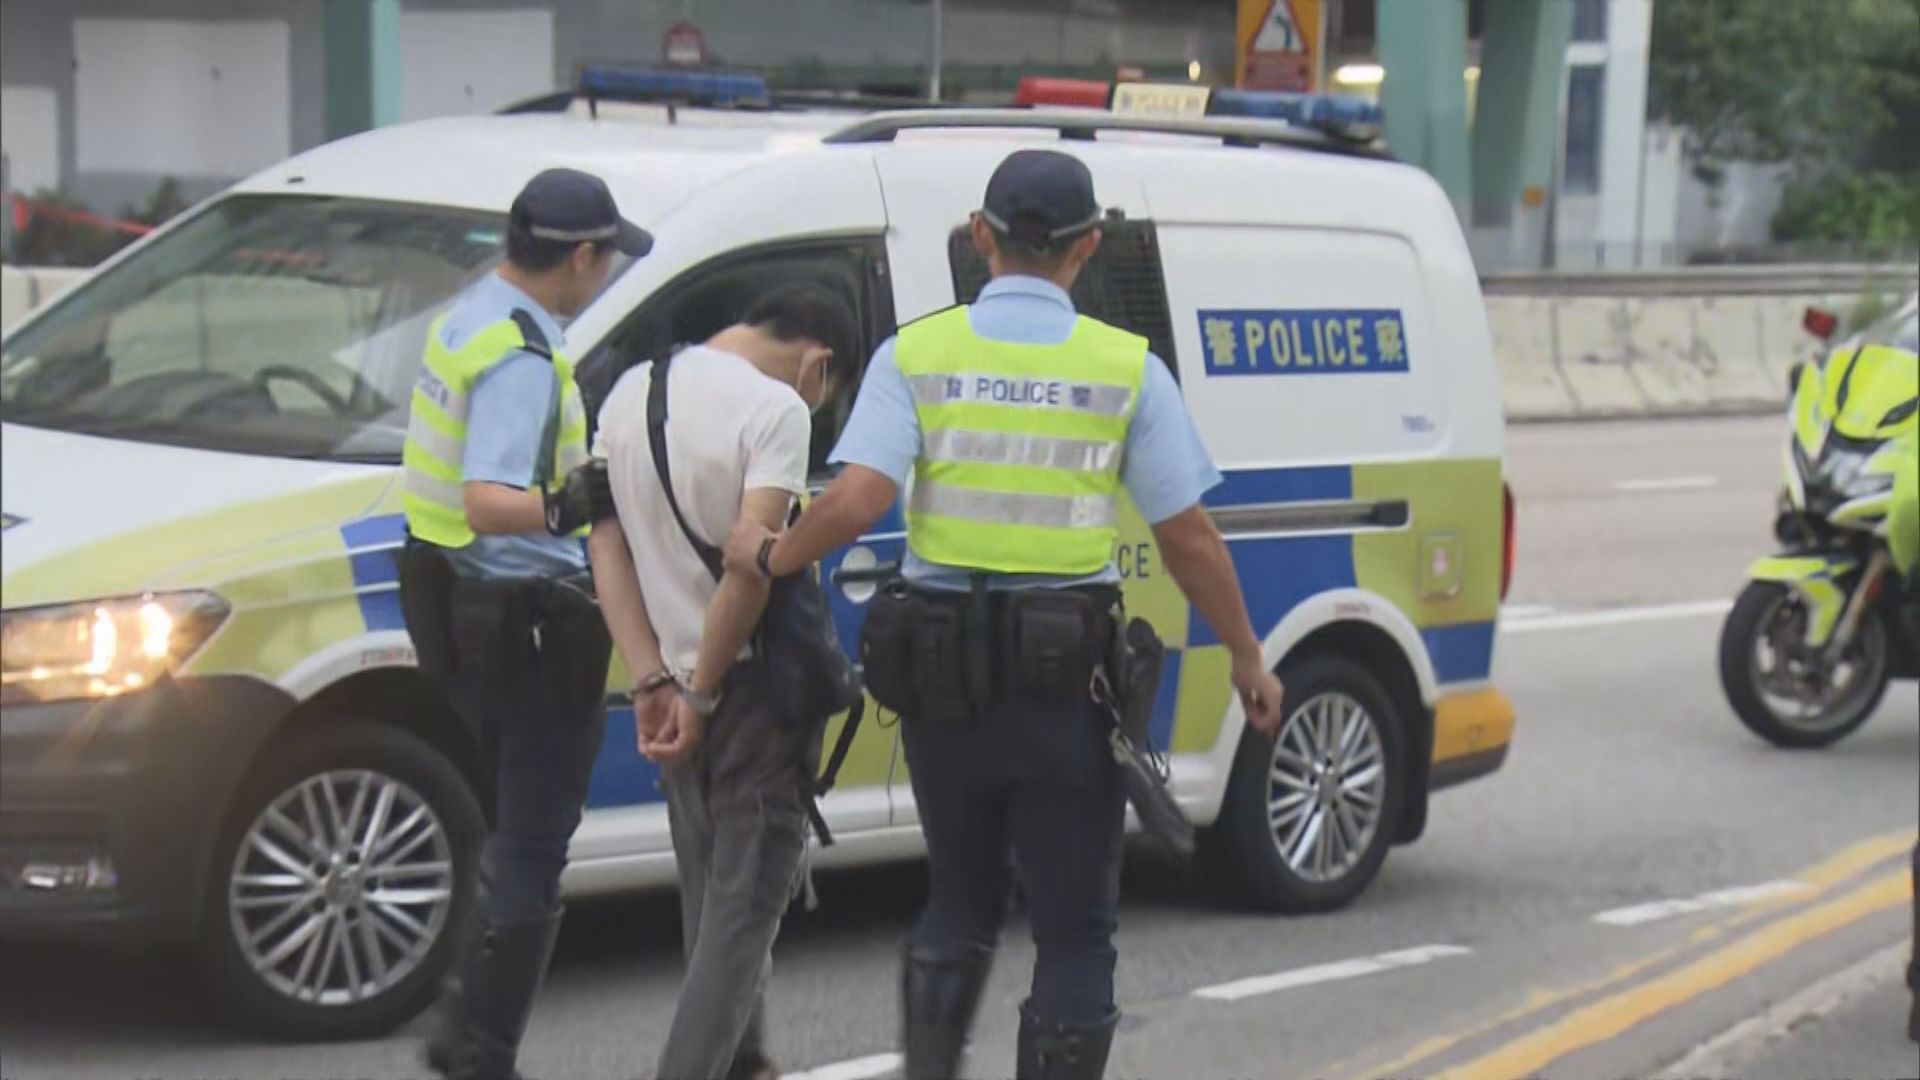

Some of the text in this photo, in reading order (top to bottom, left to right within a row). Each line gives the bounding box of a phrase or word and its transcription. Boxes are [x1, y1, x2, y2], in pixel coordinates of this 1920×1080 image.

[1244, 318, 1368, 367] POLICE
[976, 377, 1061, 405] POLICE
[1118, 543, 1150, 578] CE
